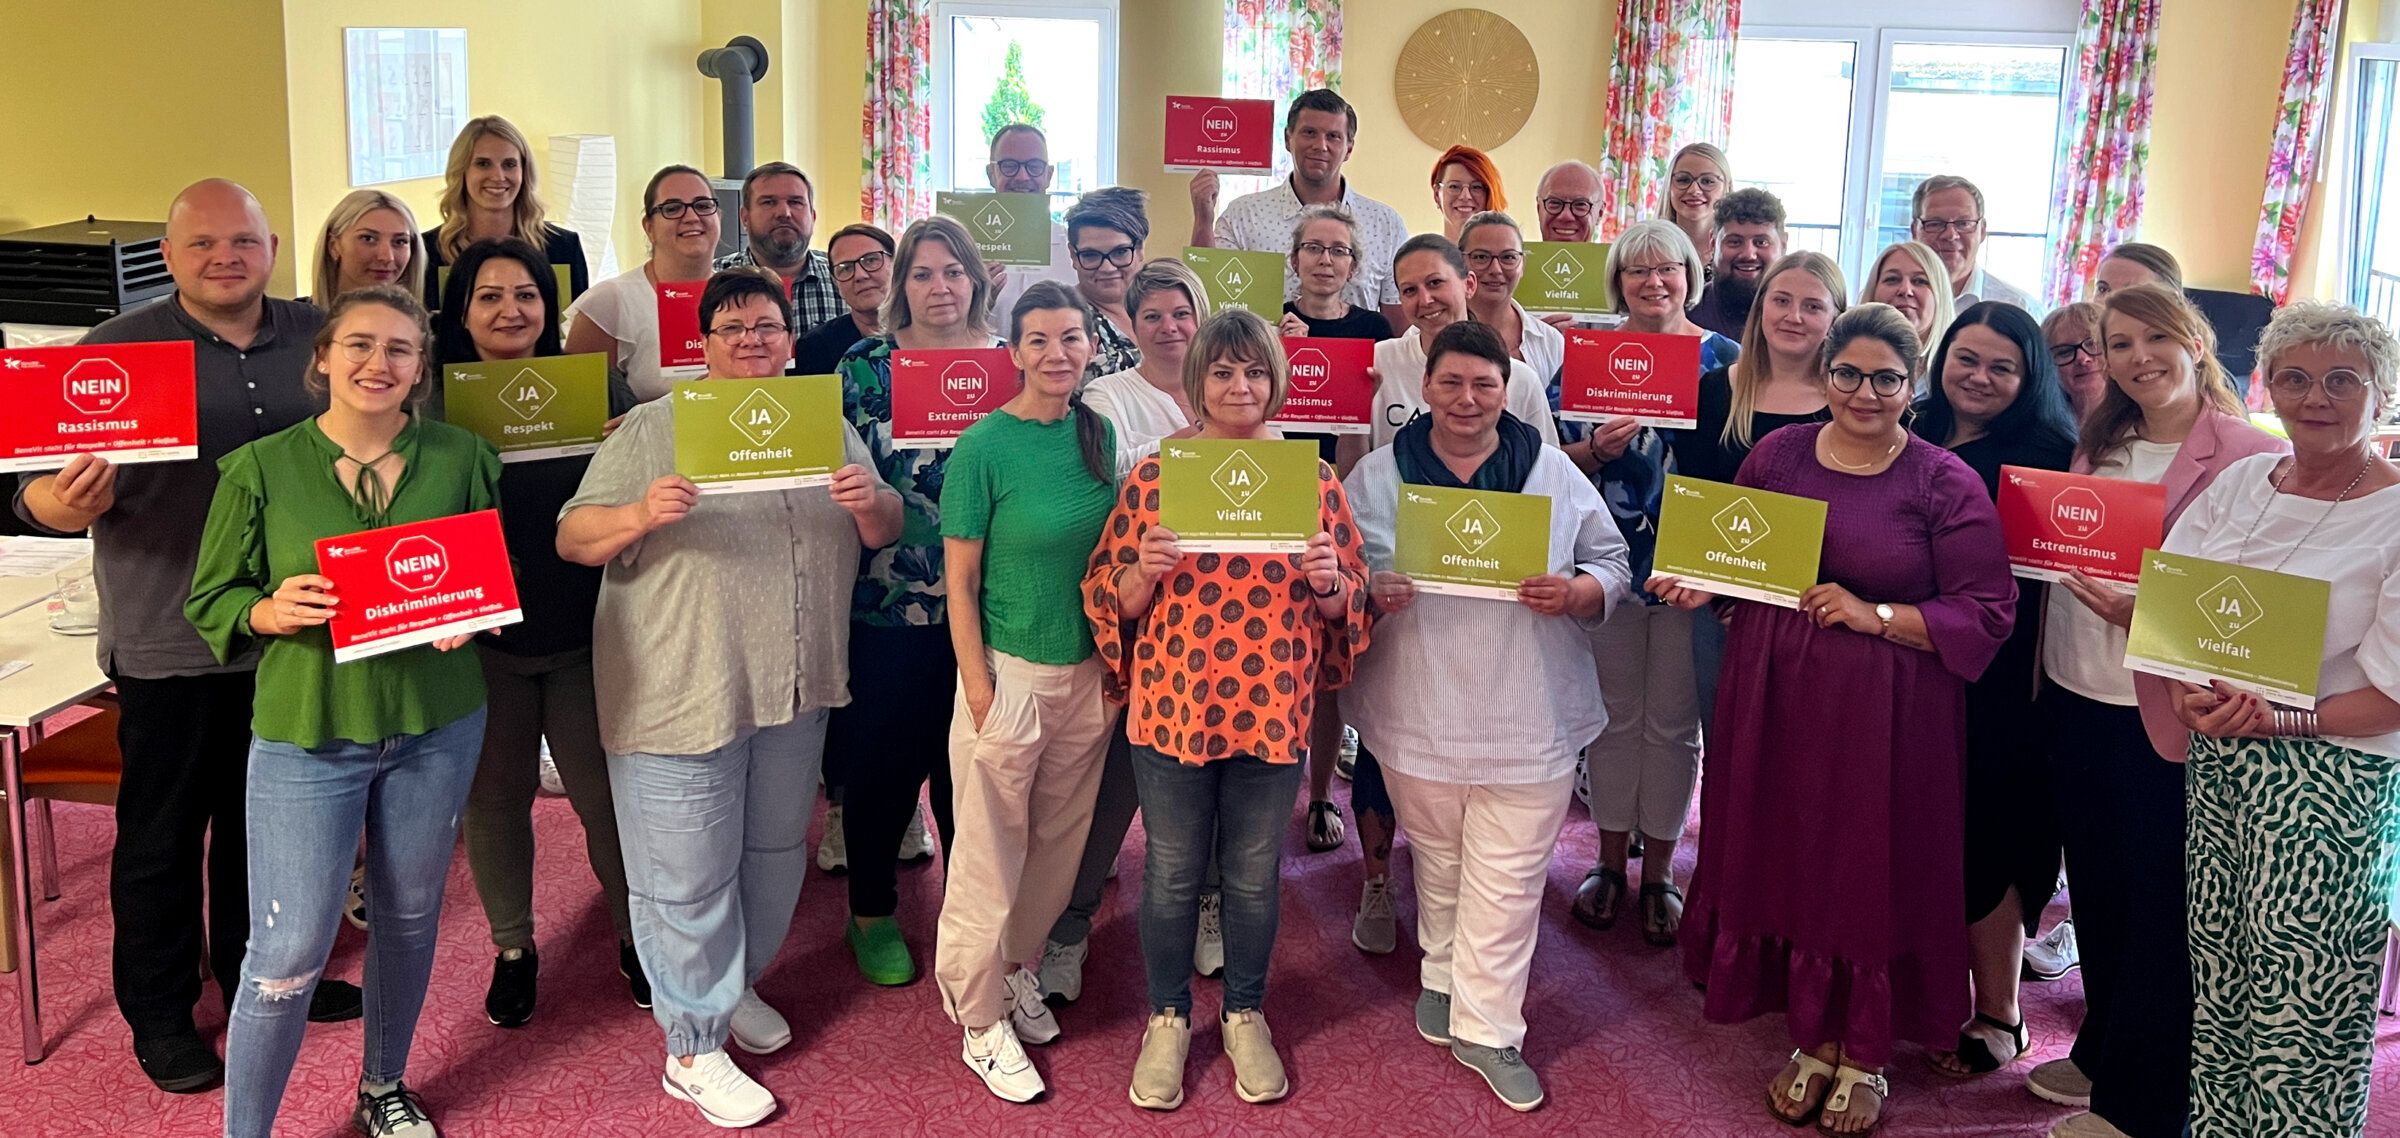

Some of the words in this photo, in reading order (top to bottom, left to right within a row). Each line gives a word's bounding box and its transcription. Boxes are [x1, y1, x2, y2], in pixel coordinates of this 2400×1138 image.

[1206, 119, 1233, 130] NEIN
[1197, 145, 1241, 154] Rassismus
[986, 214, 1002, 226] JA
[1554, 263, 1571, 274] JA
[1227, 272, 1242, 284] JA
[1545, 290, 1579, 299] Vielfalt
[1292, 364, 1325, 377] NEIN
[1614, 358, 1648, 372] NEIN
[71, 377, 121, 396] NEIN
[947, 377, 983, 390] NEIN
[99, 397, 112, 406] zu
[516, 385, 540, 402] JA
[1285, 396, 1333, 406] assismus
[1586, 387, 1673, 404] Diskriminierung
[748, 408, 772, 426] JA
[928, 410, 989, 421] Extremism
[57, 418, 138, 434] Rassismus
[503, 420, 555, 435] Respekt
[728, 446, 793, 462] Offenheit
[1227, 469, 1251, 486] JA
[1216, 509, 1263, 521] Vielfalt
[2057, 504, 2098, 523] NEIN
[1461, 518, 1484, 535] JA
[1729, 515, 1752, 534] JA
[2032, 538, 2117, 561] Extremismus
[394, 552, 441, 576] NEIN
[1441, 554, 1500, 570] Offenheit
[1705, 550, 1768, 572] Offenheit
[422, 573, 434, 582] zu
[365, 586, 485, 621] Diskriminierung
[2216, 596, 2243, 618] JA
[2229, 622, 2240, 630] zu
[2197, 637, 2251, 660] Vielfalt
